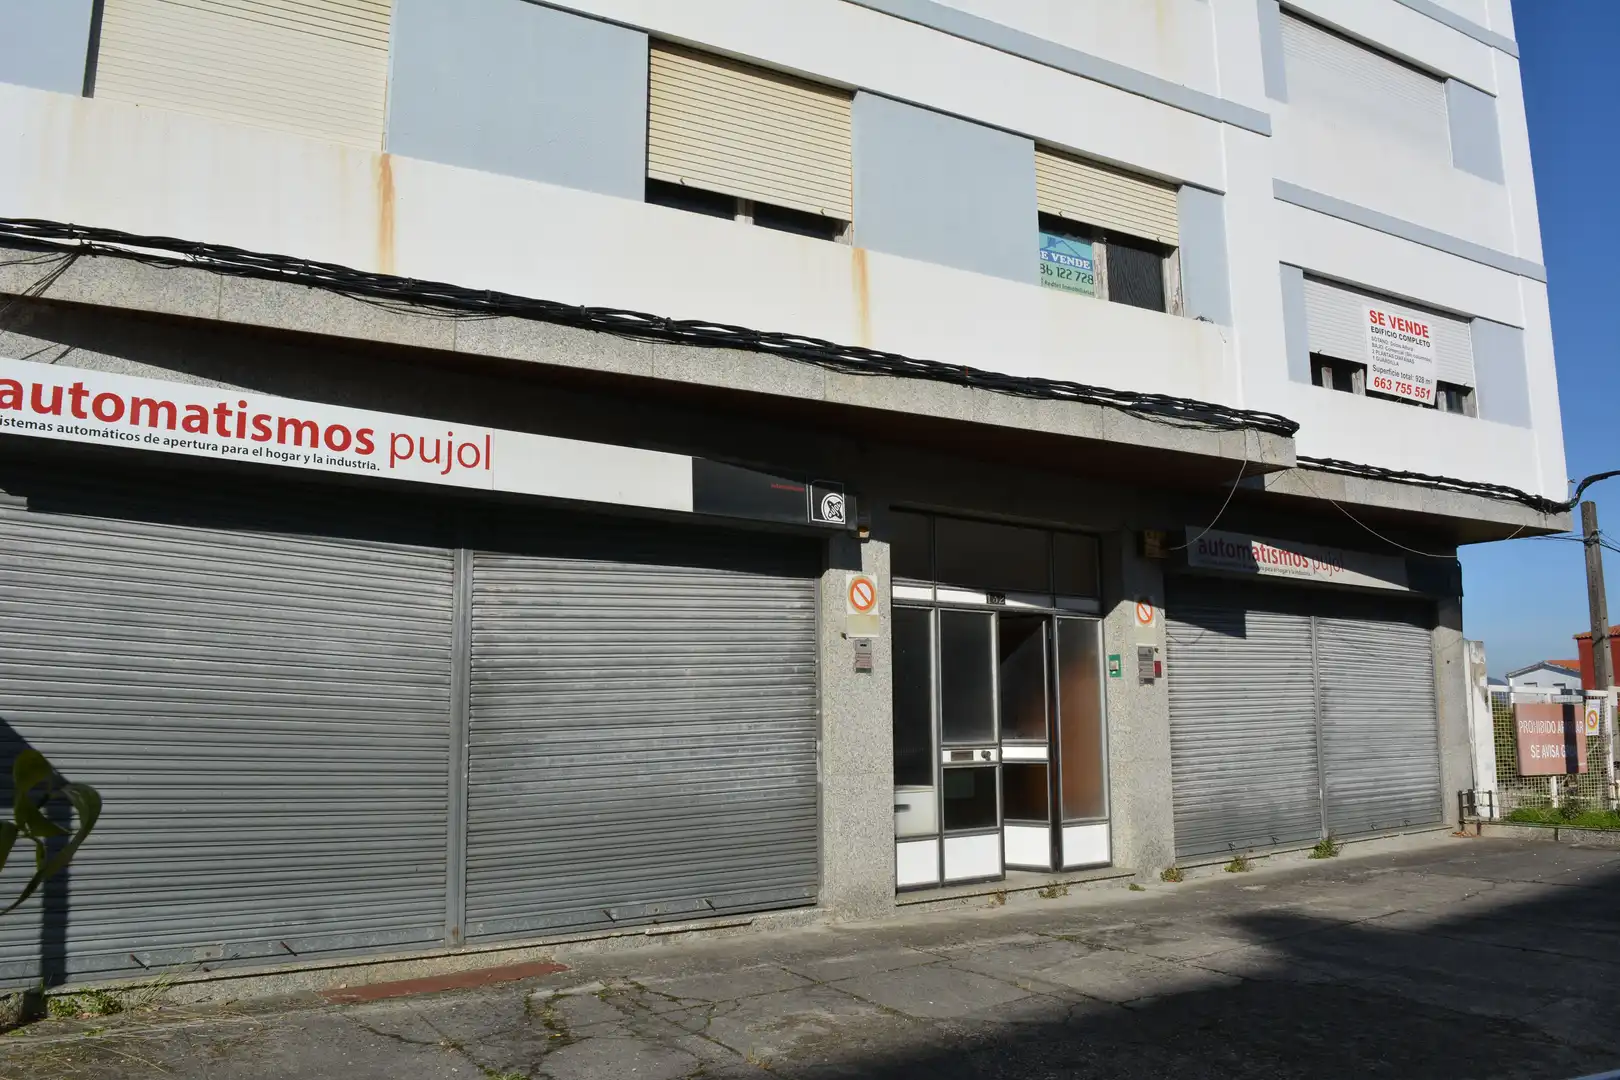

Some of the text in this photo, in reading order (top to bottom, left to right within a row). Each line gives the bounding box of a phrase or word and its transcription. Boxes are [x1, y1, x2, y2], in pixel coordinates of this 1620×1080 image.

[1051, 252, 1091, 270] VENDE
[1056, 266, 1072, 281] 122
[1074, 270, 1094, 285] 728
[1369, 310, 1430, 339] SE VENDE
[1370, 325, 1431, 348] EDIFICIO COMPLETO
[1372, 364, 1400, 378] Superficie
[1401, 372, 1414, 381] total:
[1415, 374, 1425, 384] 928
[1373, 376, 1431, 400] 663 755 551
[0, 378, 491, 475] automatismos pujol
[56, 423, 140, 442] automáticos
[143, 432, 160, 445] de
[163, 437, 218, 452] apertura
[221, 443, 249, 455] para
[252, 446, 263, 457] el
[265, 448, 301, 463] hogar
[303, 454, 311, 465] y
[313, 453, 323, 464] la
[326, 455, 381, 471] industria.
[1198, 537, 1309, 569] automatismos
[1312, 550, 1345, 577] pujol
[1518, 720, 1556, 734] PROHIBIDO
[1530, 744, 1541, 759] SE
[1541, 744, 1560, 759] AVISA
